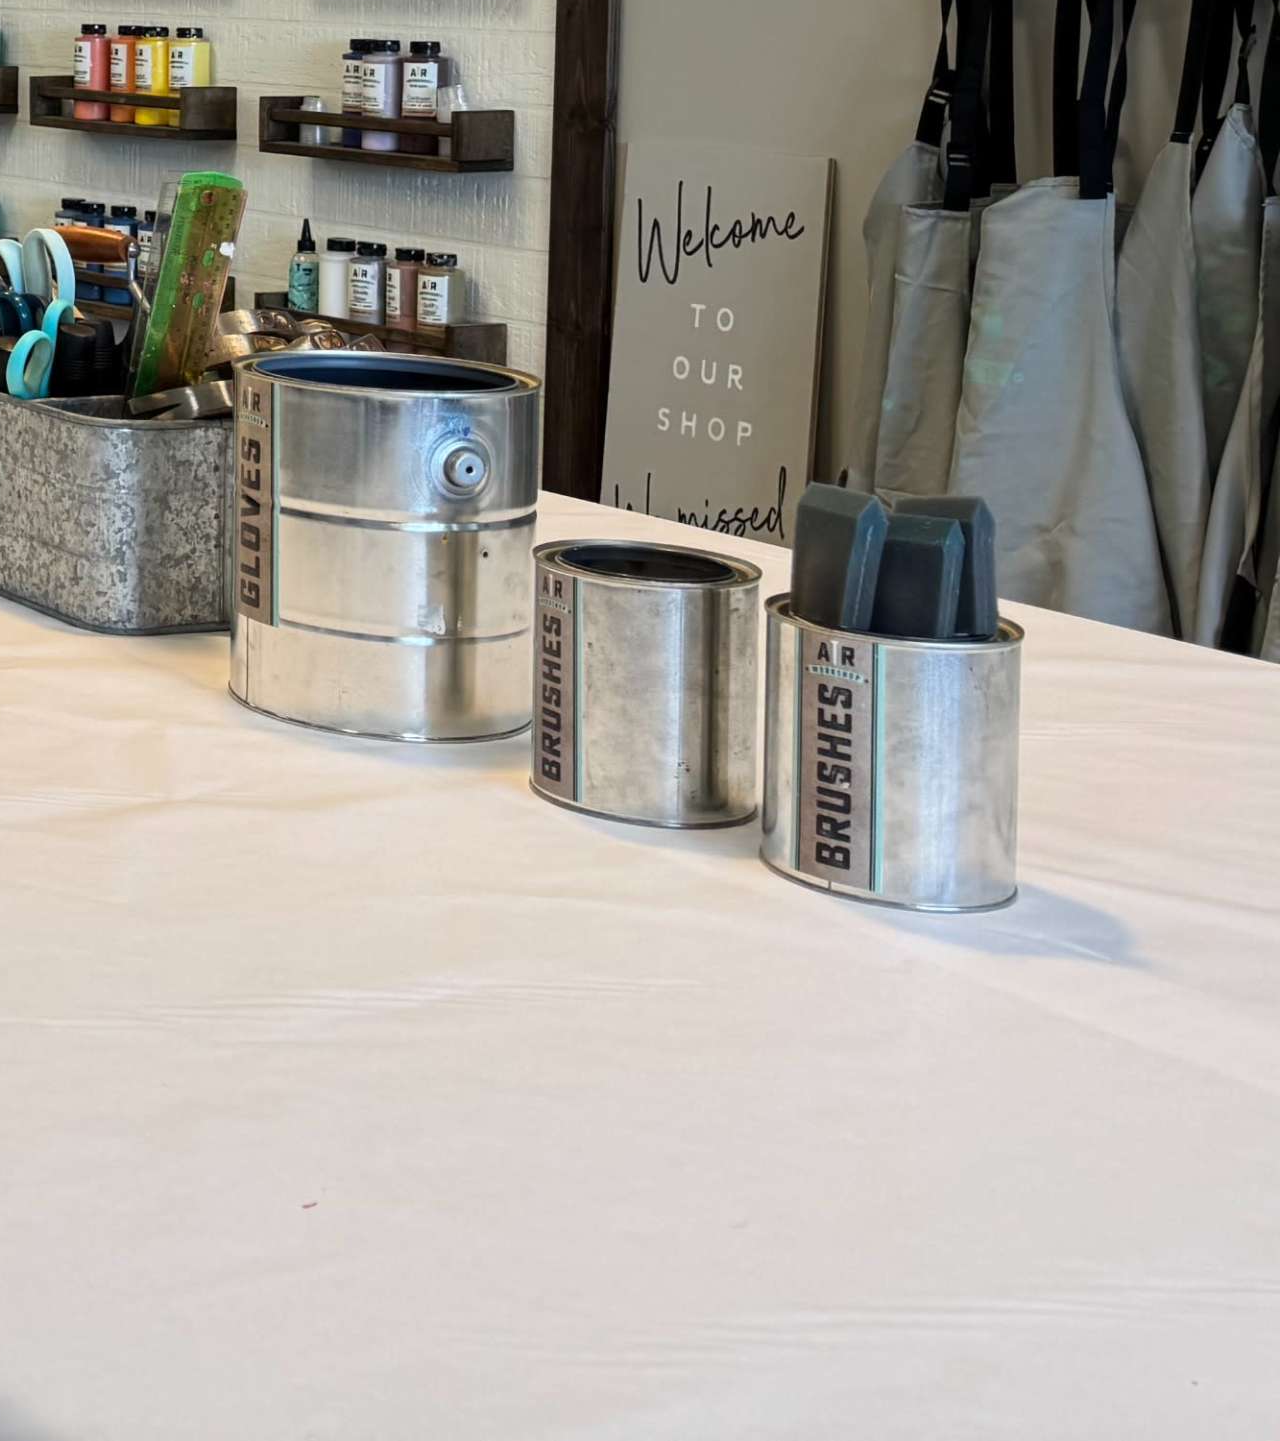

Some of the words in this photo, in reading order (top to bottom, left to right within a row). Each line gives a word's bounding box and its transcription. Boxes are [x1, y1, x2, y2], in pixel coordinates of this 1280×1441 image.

[638, 180, 804, 285] Welcome
[690, 304, 734, 331] TO
[672, 356, 743, 390] OUR
[657, 407, 753, 446] SHOP
[240, 435, 261, 609] GLOVES
[677, 466, 787, 540] missed
[541, 613, 561, 782] BRUSHES
[816, 683, 852, 870] BRUSHES
